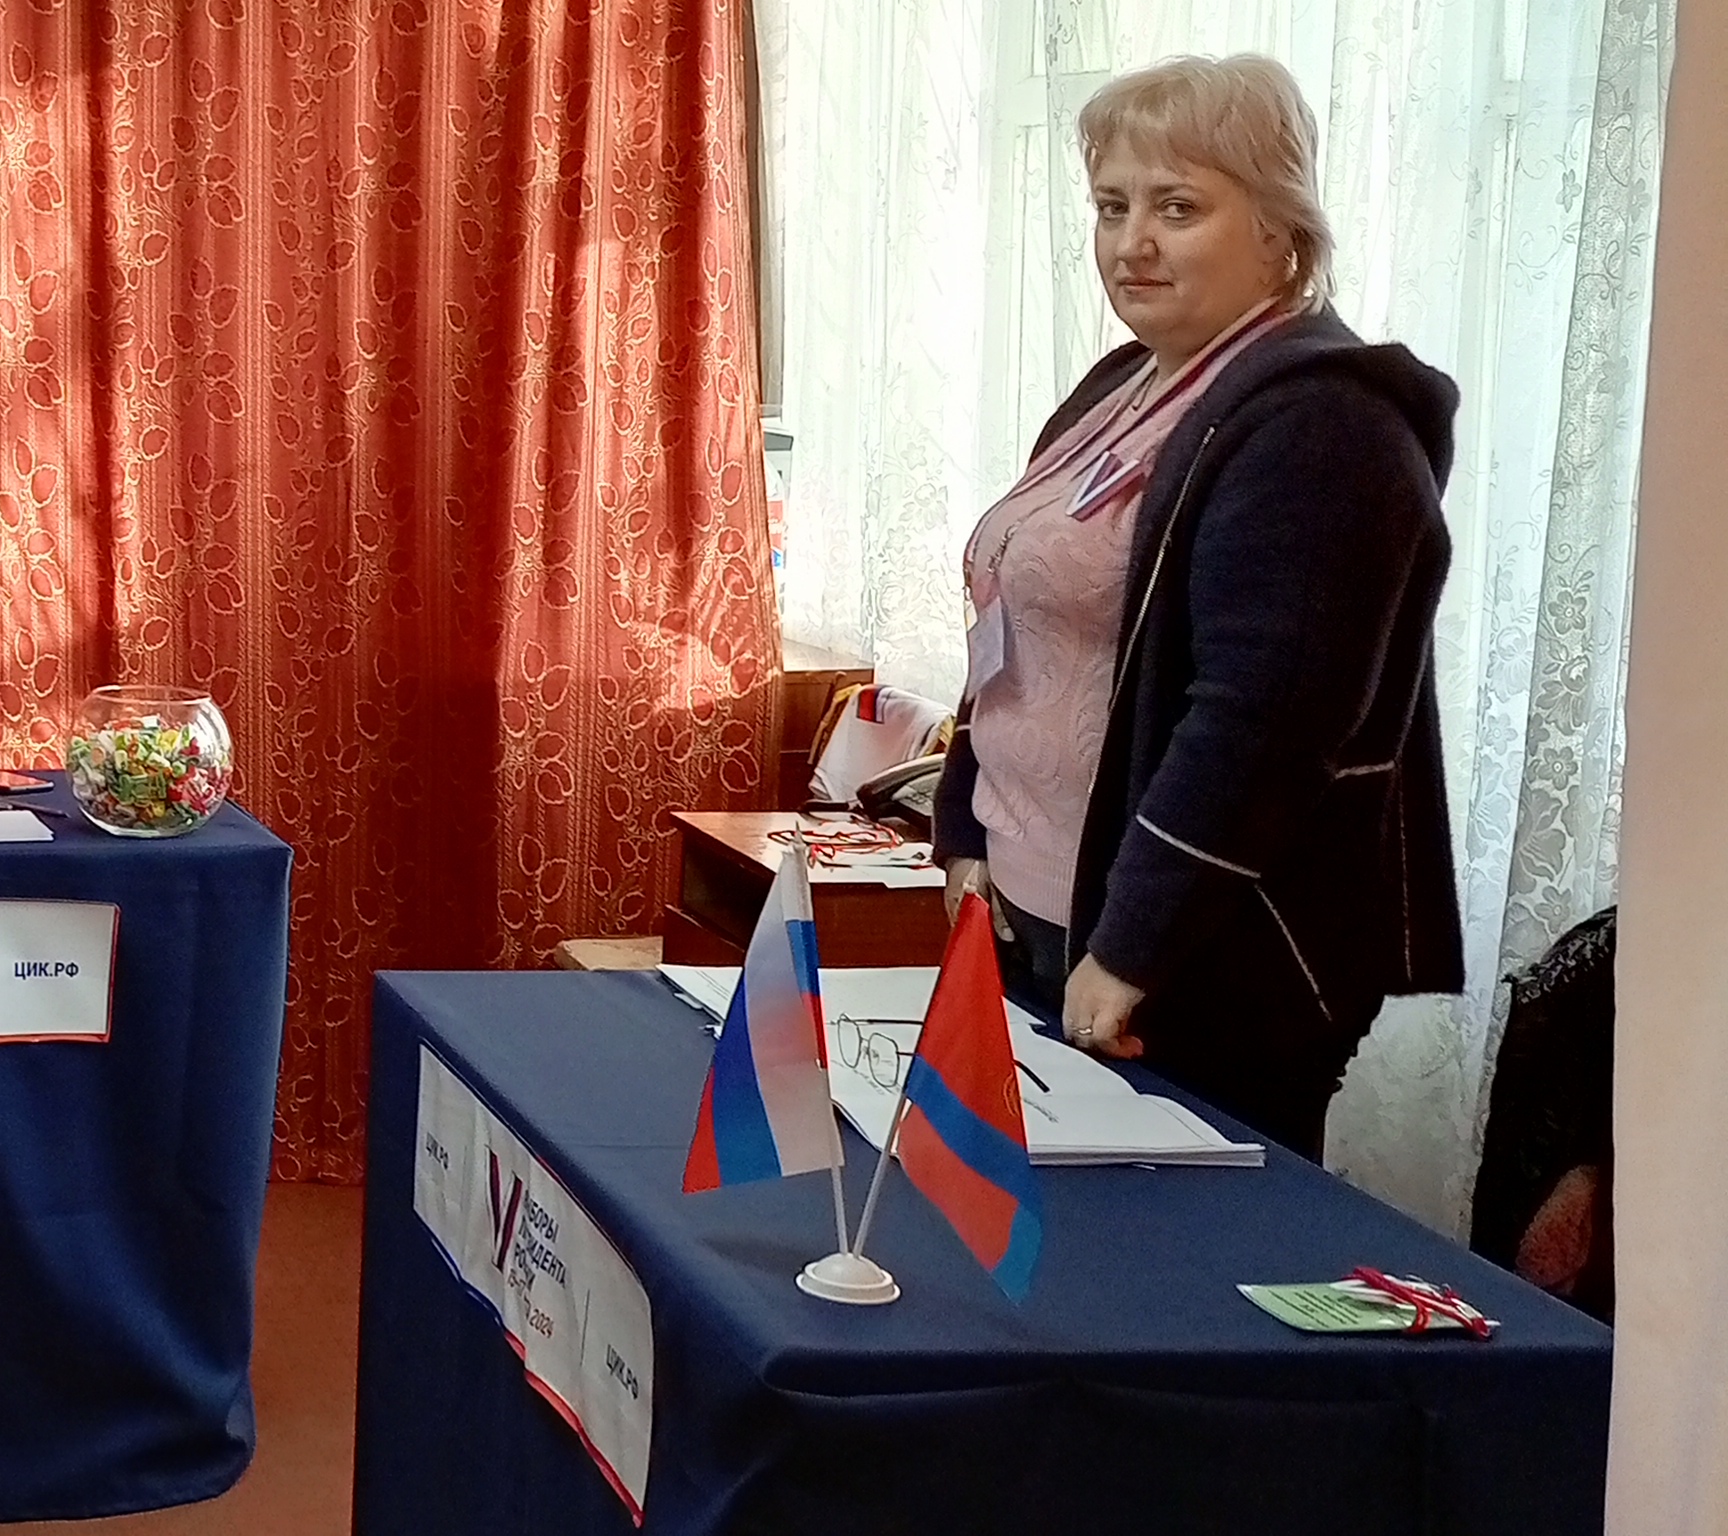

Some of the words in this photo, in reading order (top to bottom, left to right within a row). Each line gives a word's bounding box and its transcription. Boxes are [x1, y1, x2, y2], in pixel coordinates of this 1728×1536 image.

[14, 962, 79, 980] ЦИК.РФ
[523, 1190, 560, 1244] БОРЫ
[529, 1307, 555, 1339] 2024
[606, 1344, 639, 1400] ЦИК.РФ
